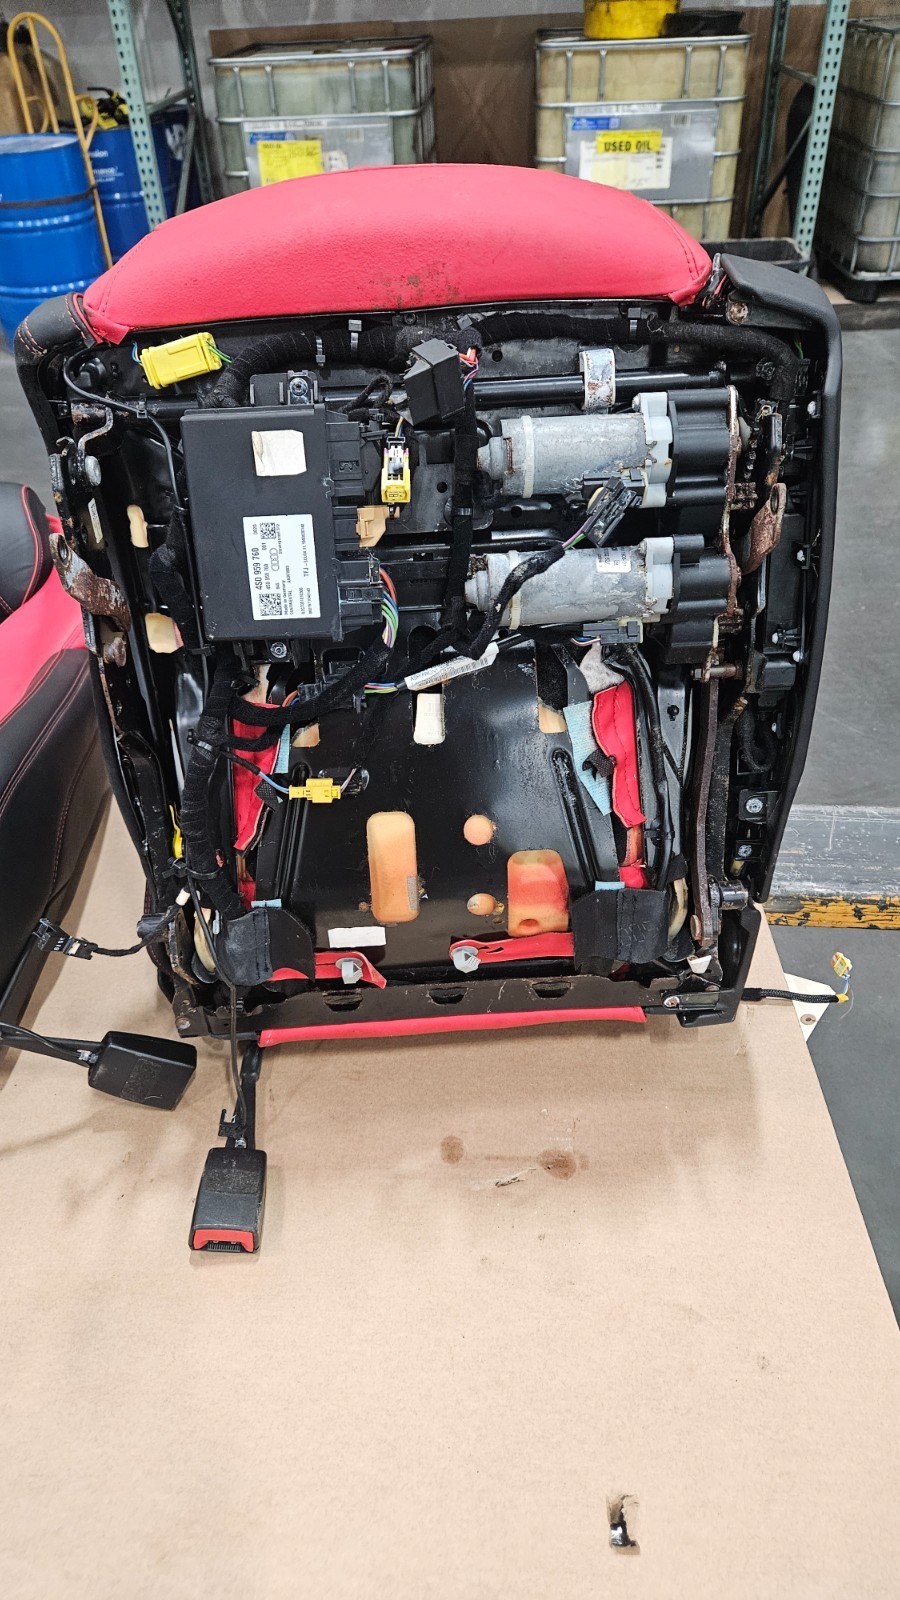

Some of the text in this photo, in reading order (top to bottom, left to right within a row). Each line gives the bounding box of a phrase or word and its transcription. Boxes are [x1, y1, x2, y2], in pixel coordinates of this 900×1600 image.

[604, 140, 652, 152] USED OIL
[251, 547, 263, 590] 4S0 959 760
